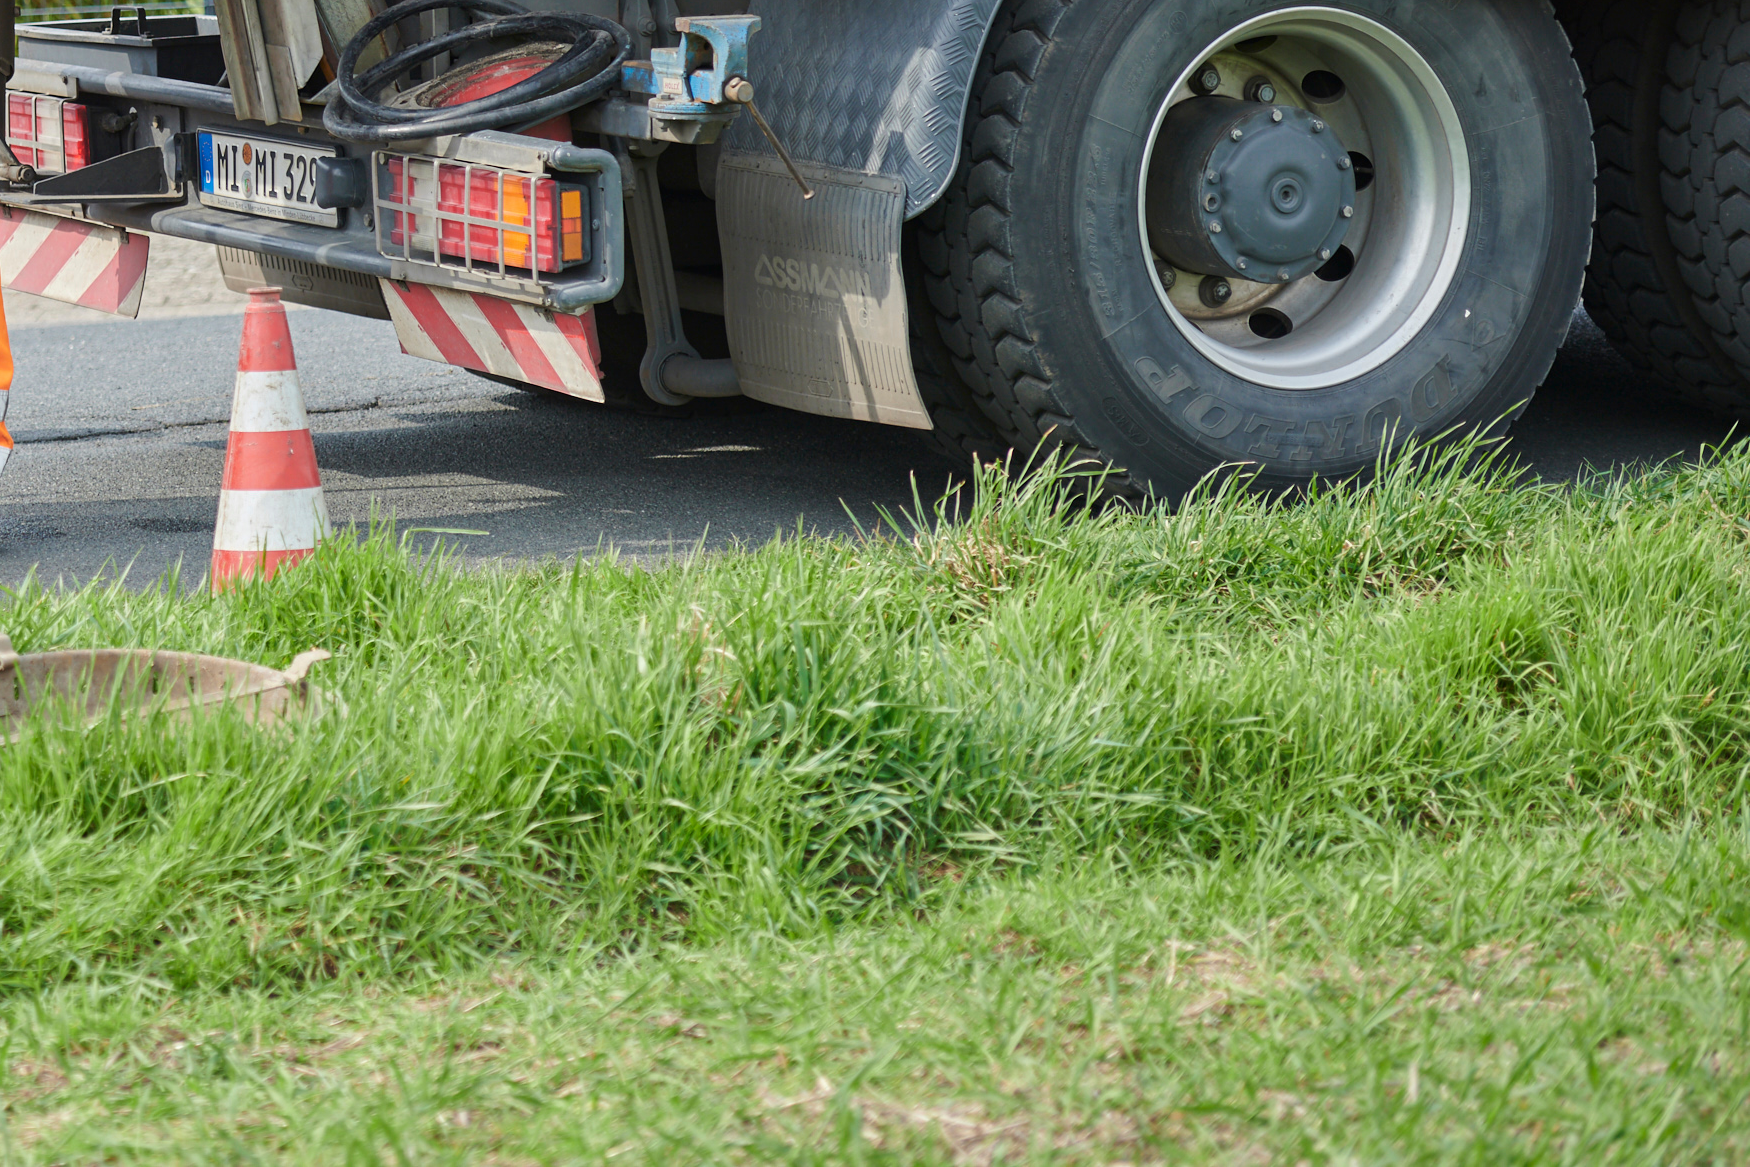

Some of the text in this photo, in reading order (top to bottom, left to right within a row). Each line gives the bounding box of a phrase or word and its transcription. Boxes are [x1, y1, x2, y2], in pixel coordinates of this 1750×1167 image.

[205, 170, 211, 184] D
[217, 142, 239, 192] MI
[255, 148, 278, 198] MI
[754, 253, 873, 305] ASSMANN
[1133, 353, 1458, 461] DUNLOP
